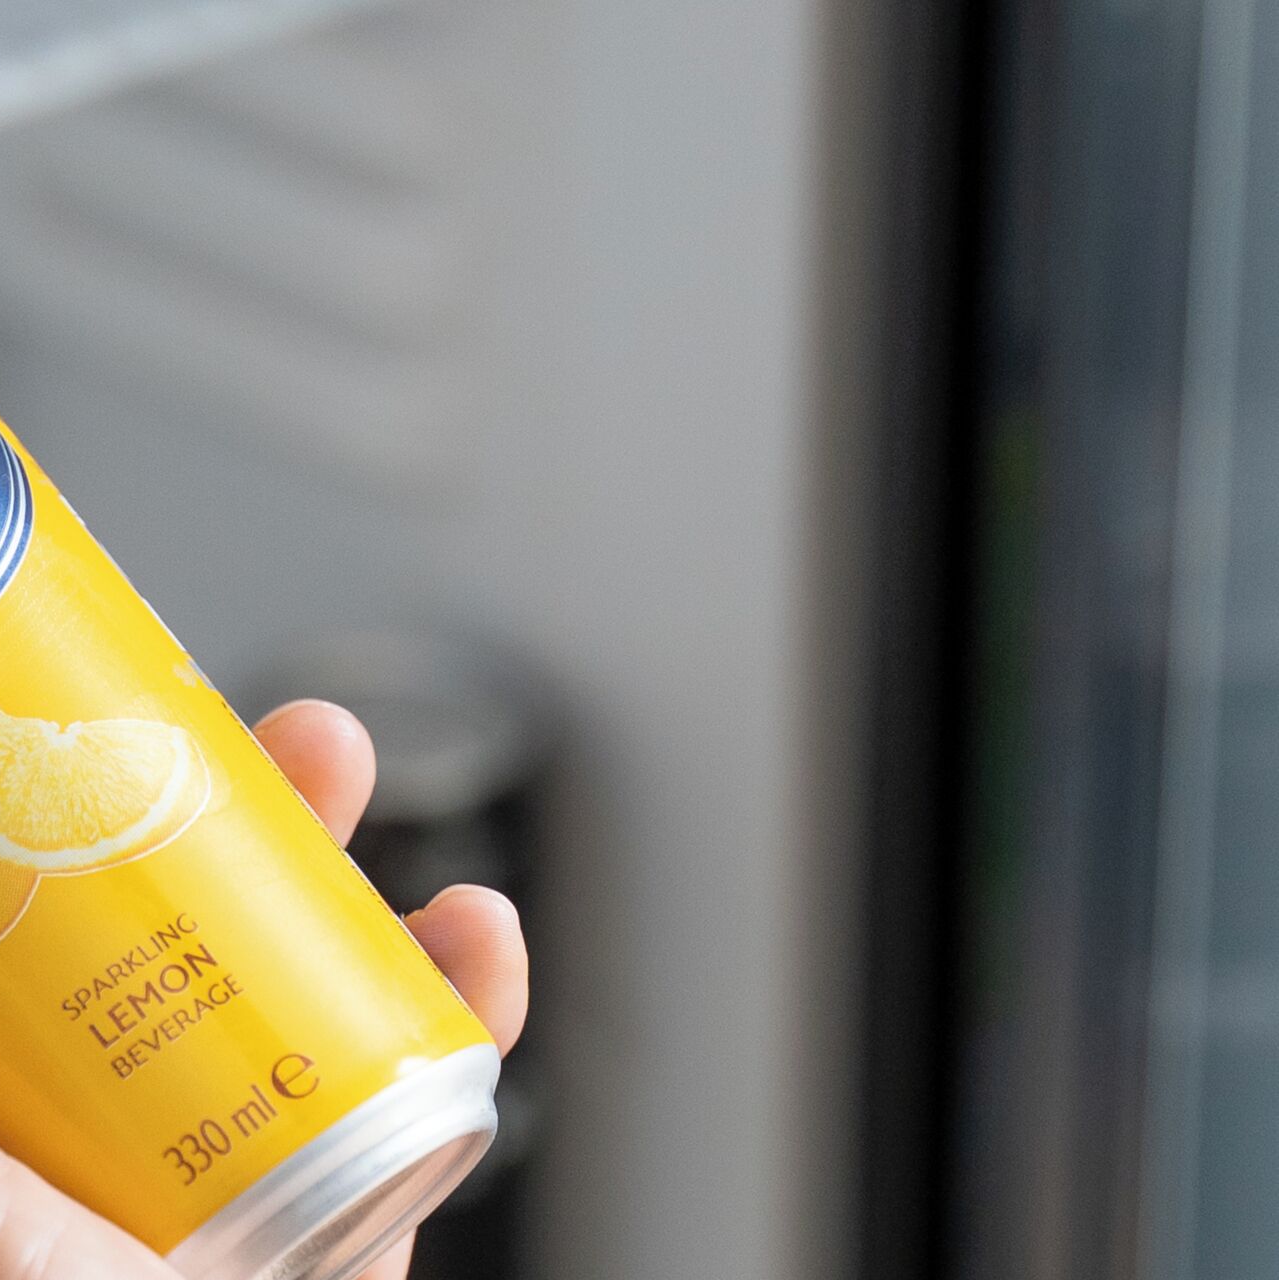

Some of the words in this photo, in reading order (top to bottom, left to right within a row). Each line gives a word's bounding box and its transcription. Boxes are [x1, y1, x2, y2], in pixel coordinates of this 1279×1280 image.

[61, 912, 201, 1022] SPARKLING
[88, 942, 220, 1050] LEMON
[110, 973, 245, 1080] BEVERAGE
[162, 1118, 233, 1187] 330
[230, 1083, 278, 1139] ml
